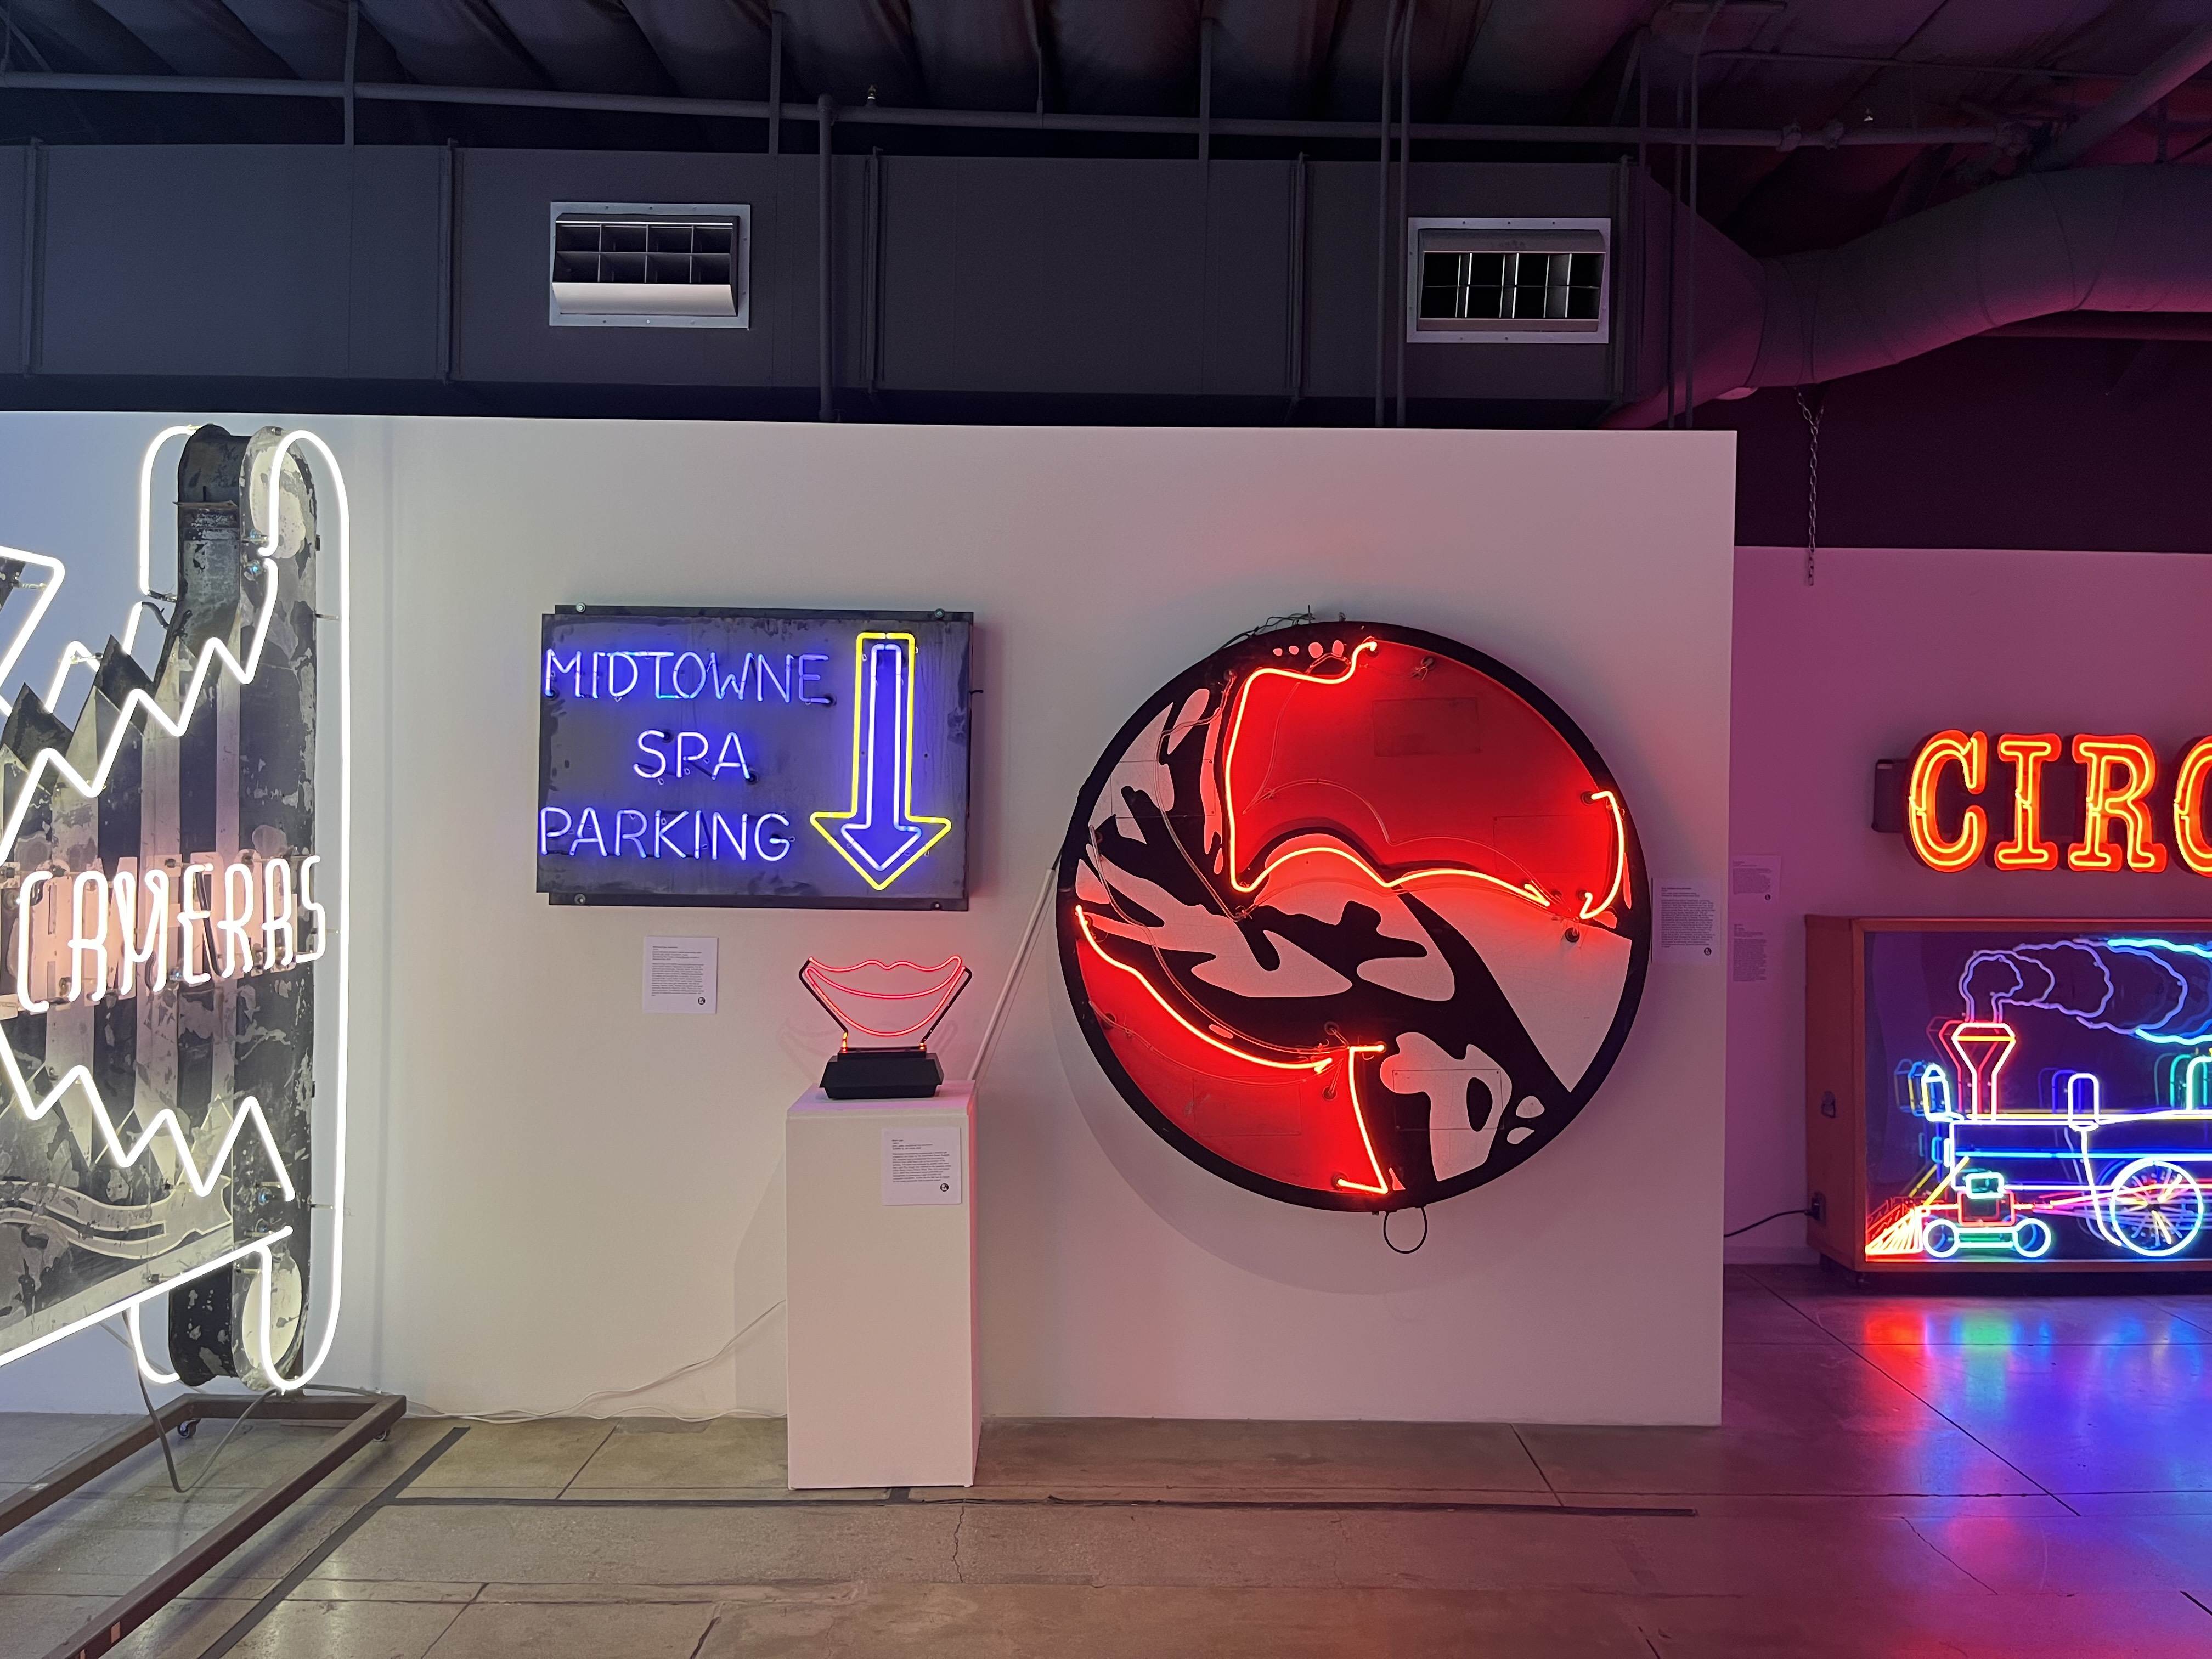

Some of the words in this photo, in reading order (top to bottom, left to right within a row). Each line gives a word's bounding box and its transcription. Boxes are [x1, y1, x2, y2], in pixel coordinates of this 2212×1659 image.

[544, 648, 830, 703] MIDTOWNE
[633, 730, 751, 780] SPA
[539, 807, 791, 862] PARKING
[17, 854, 326, 1013] CAMERAS
